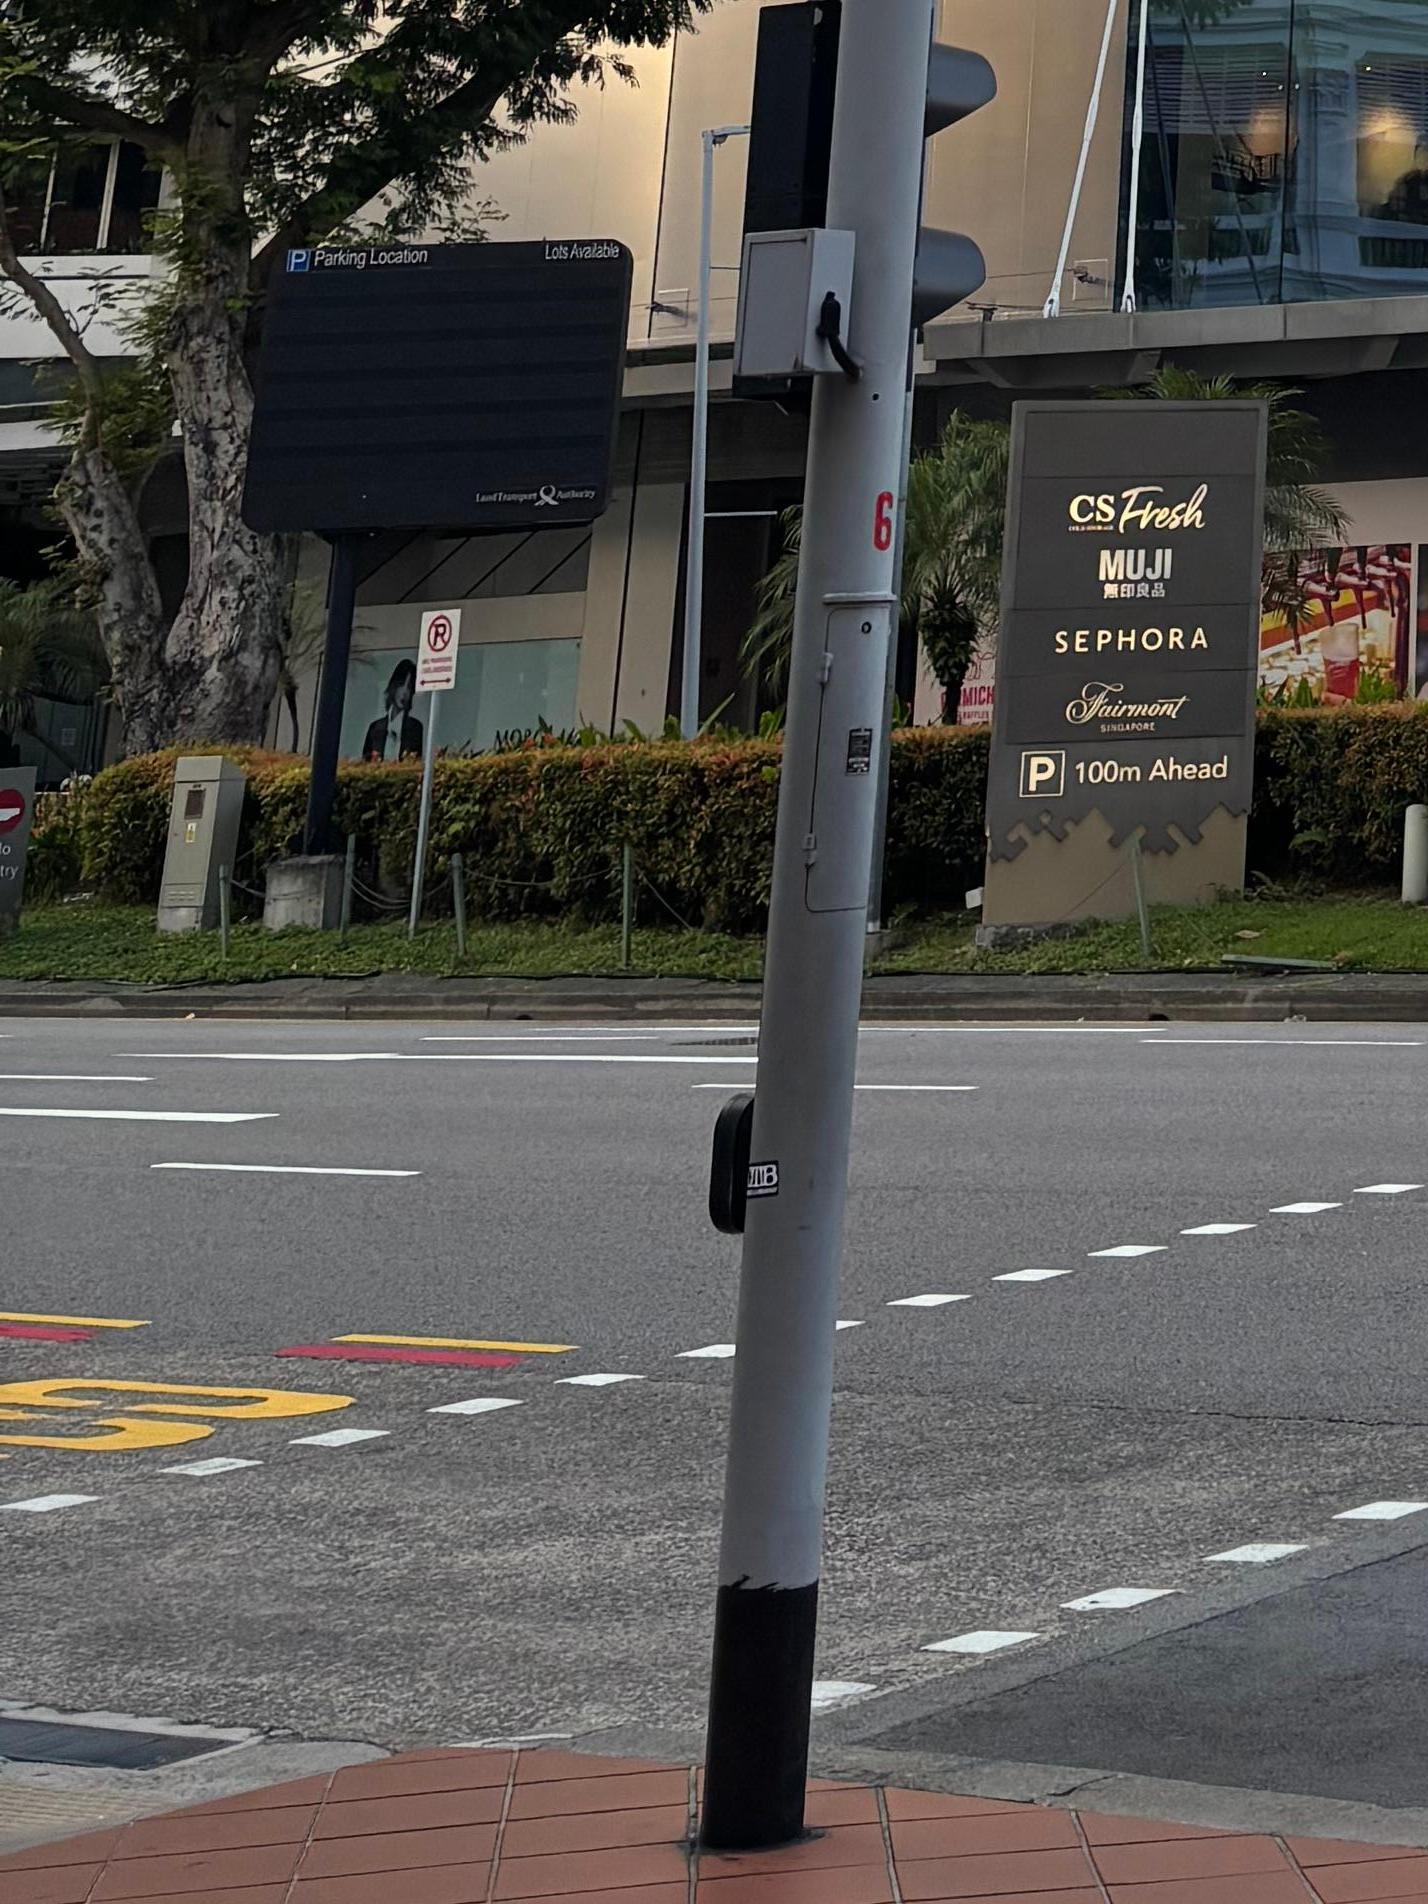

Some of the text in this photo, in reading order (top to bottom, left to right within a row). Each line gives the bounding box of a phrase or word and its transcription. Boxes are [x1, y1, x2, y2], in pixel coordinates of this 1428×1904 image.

[314, 248, 366, 270] Parking
[369, 246, 428, 265] Location
[545, 241, 620, 260] Lots Available
[873, 490, 894, 551] 6
[1069, 483, 1208, 534] CS Fresh
[1098, 548, 1173, 581] MUJI
[1055, 627, 1208, 654] SEPHORA
[1065, 681, 1191, 725] Fairmont
[1100, 722, 1156, 733] SINGAPORE
[1075, 760, 1141, 784] 100m
[1149, 755, 1228, 781] Ahead
